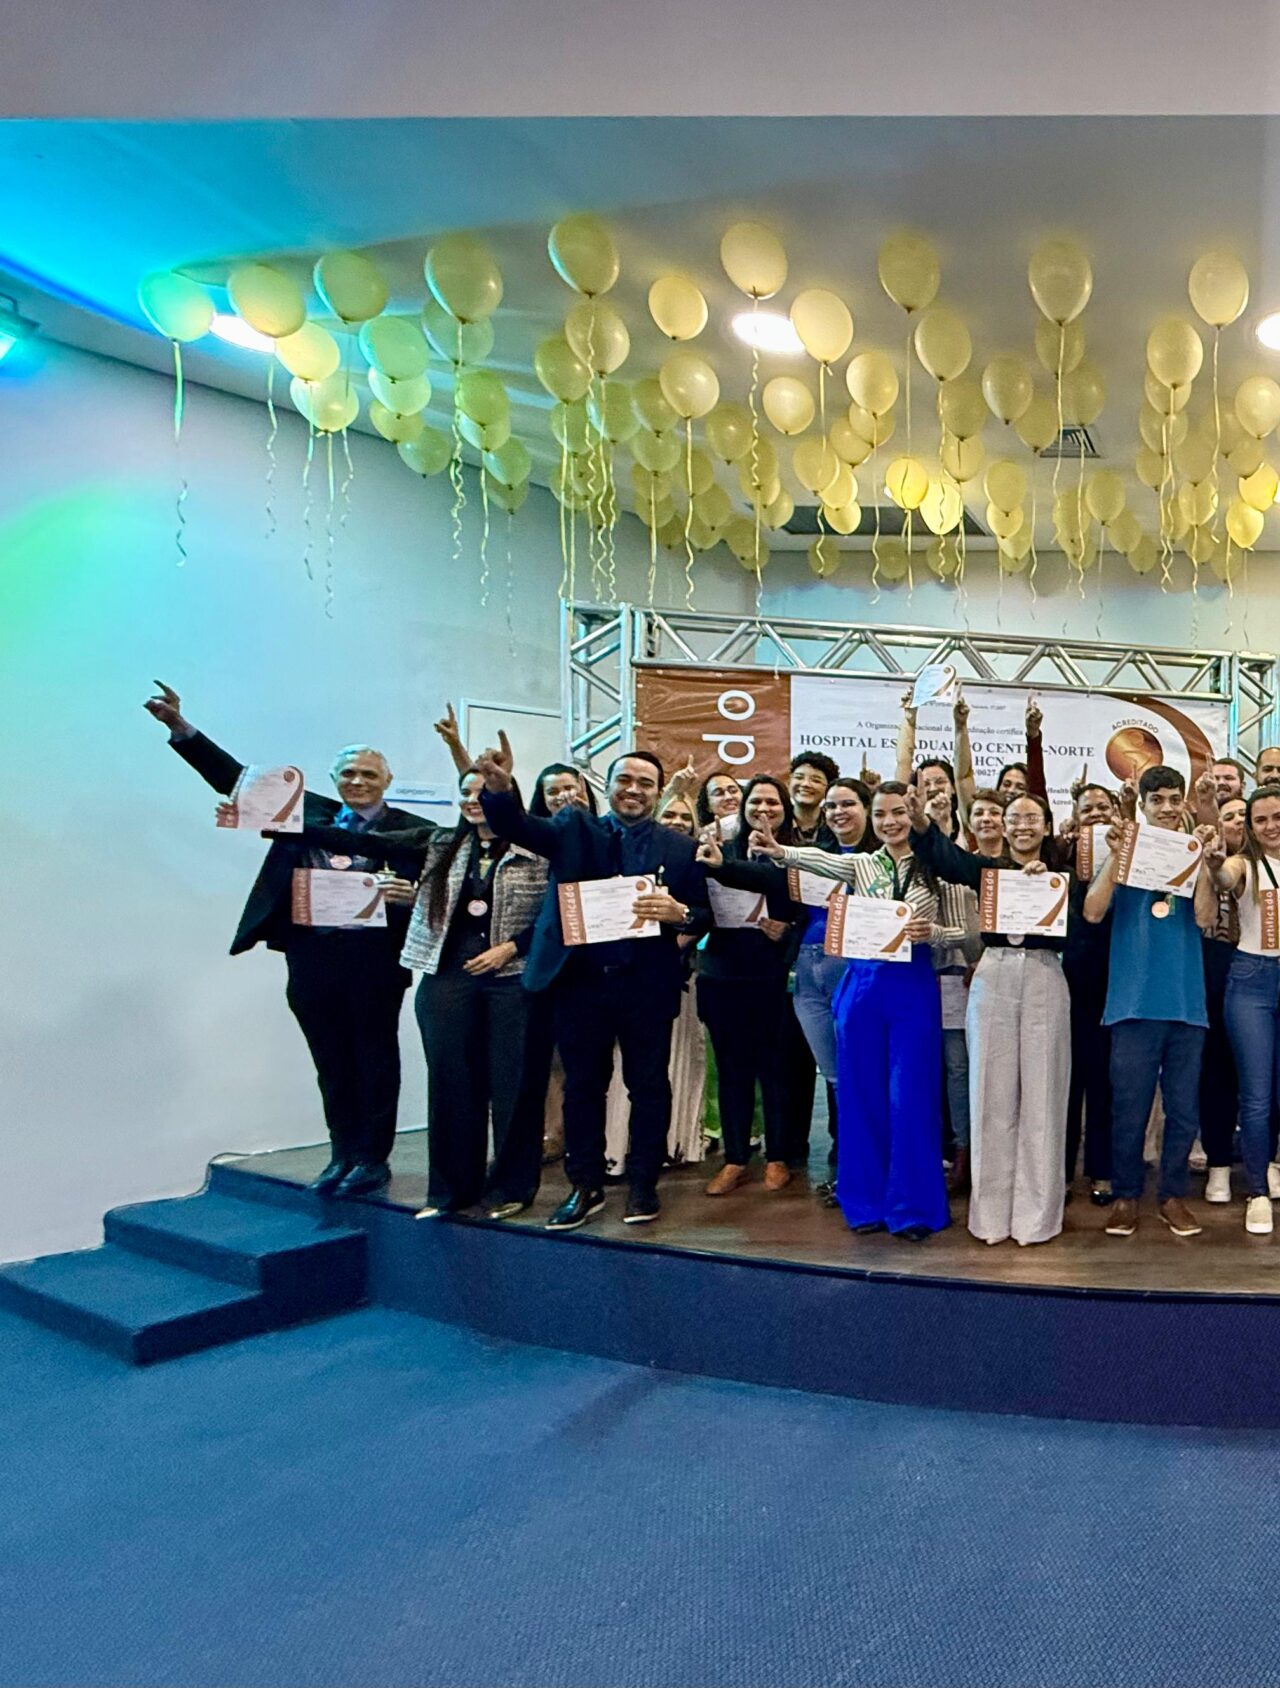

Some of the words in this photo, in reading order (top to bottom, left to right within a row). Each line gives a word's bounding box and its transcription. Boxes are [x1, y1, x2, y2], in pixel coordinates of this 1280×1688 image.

[701, 689, 756, 766] do
[800, 734, 877, 748] HOSPITAL
[881, 738, 954, 752] ESDUA
[986, 743, 1095, 757] CENT-NORTE
[865, 721, 900, 730] Organiza
[1111, 719, 1159, 734] ACREDITADO
[975, 756, 1005, 768] HCN
[1080, 827, 1089, 880] certificado
[1117, 823, 1134, 882] certificado
[565, 884, 581, 943] certificado
[830, 896, 844, 955] certificado
[984, 871, 995, 930] certificado
[1264, 891, 1275, 949] certificado
